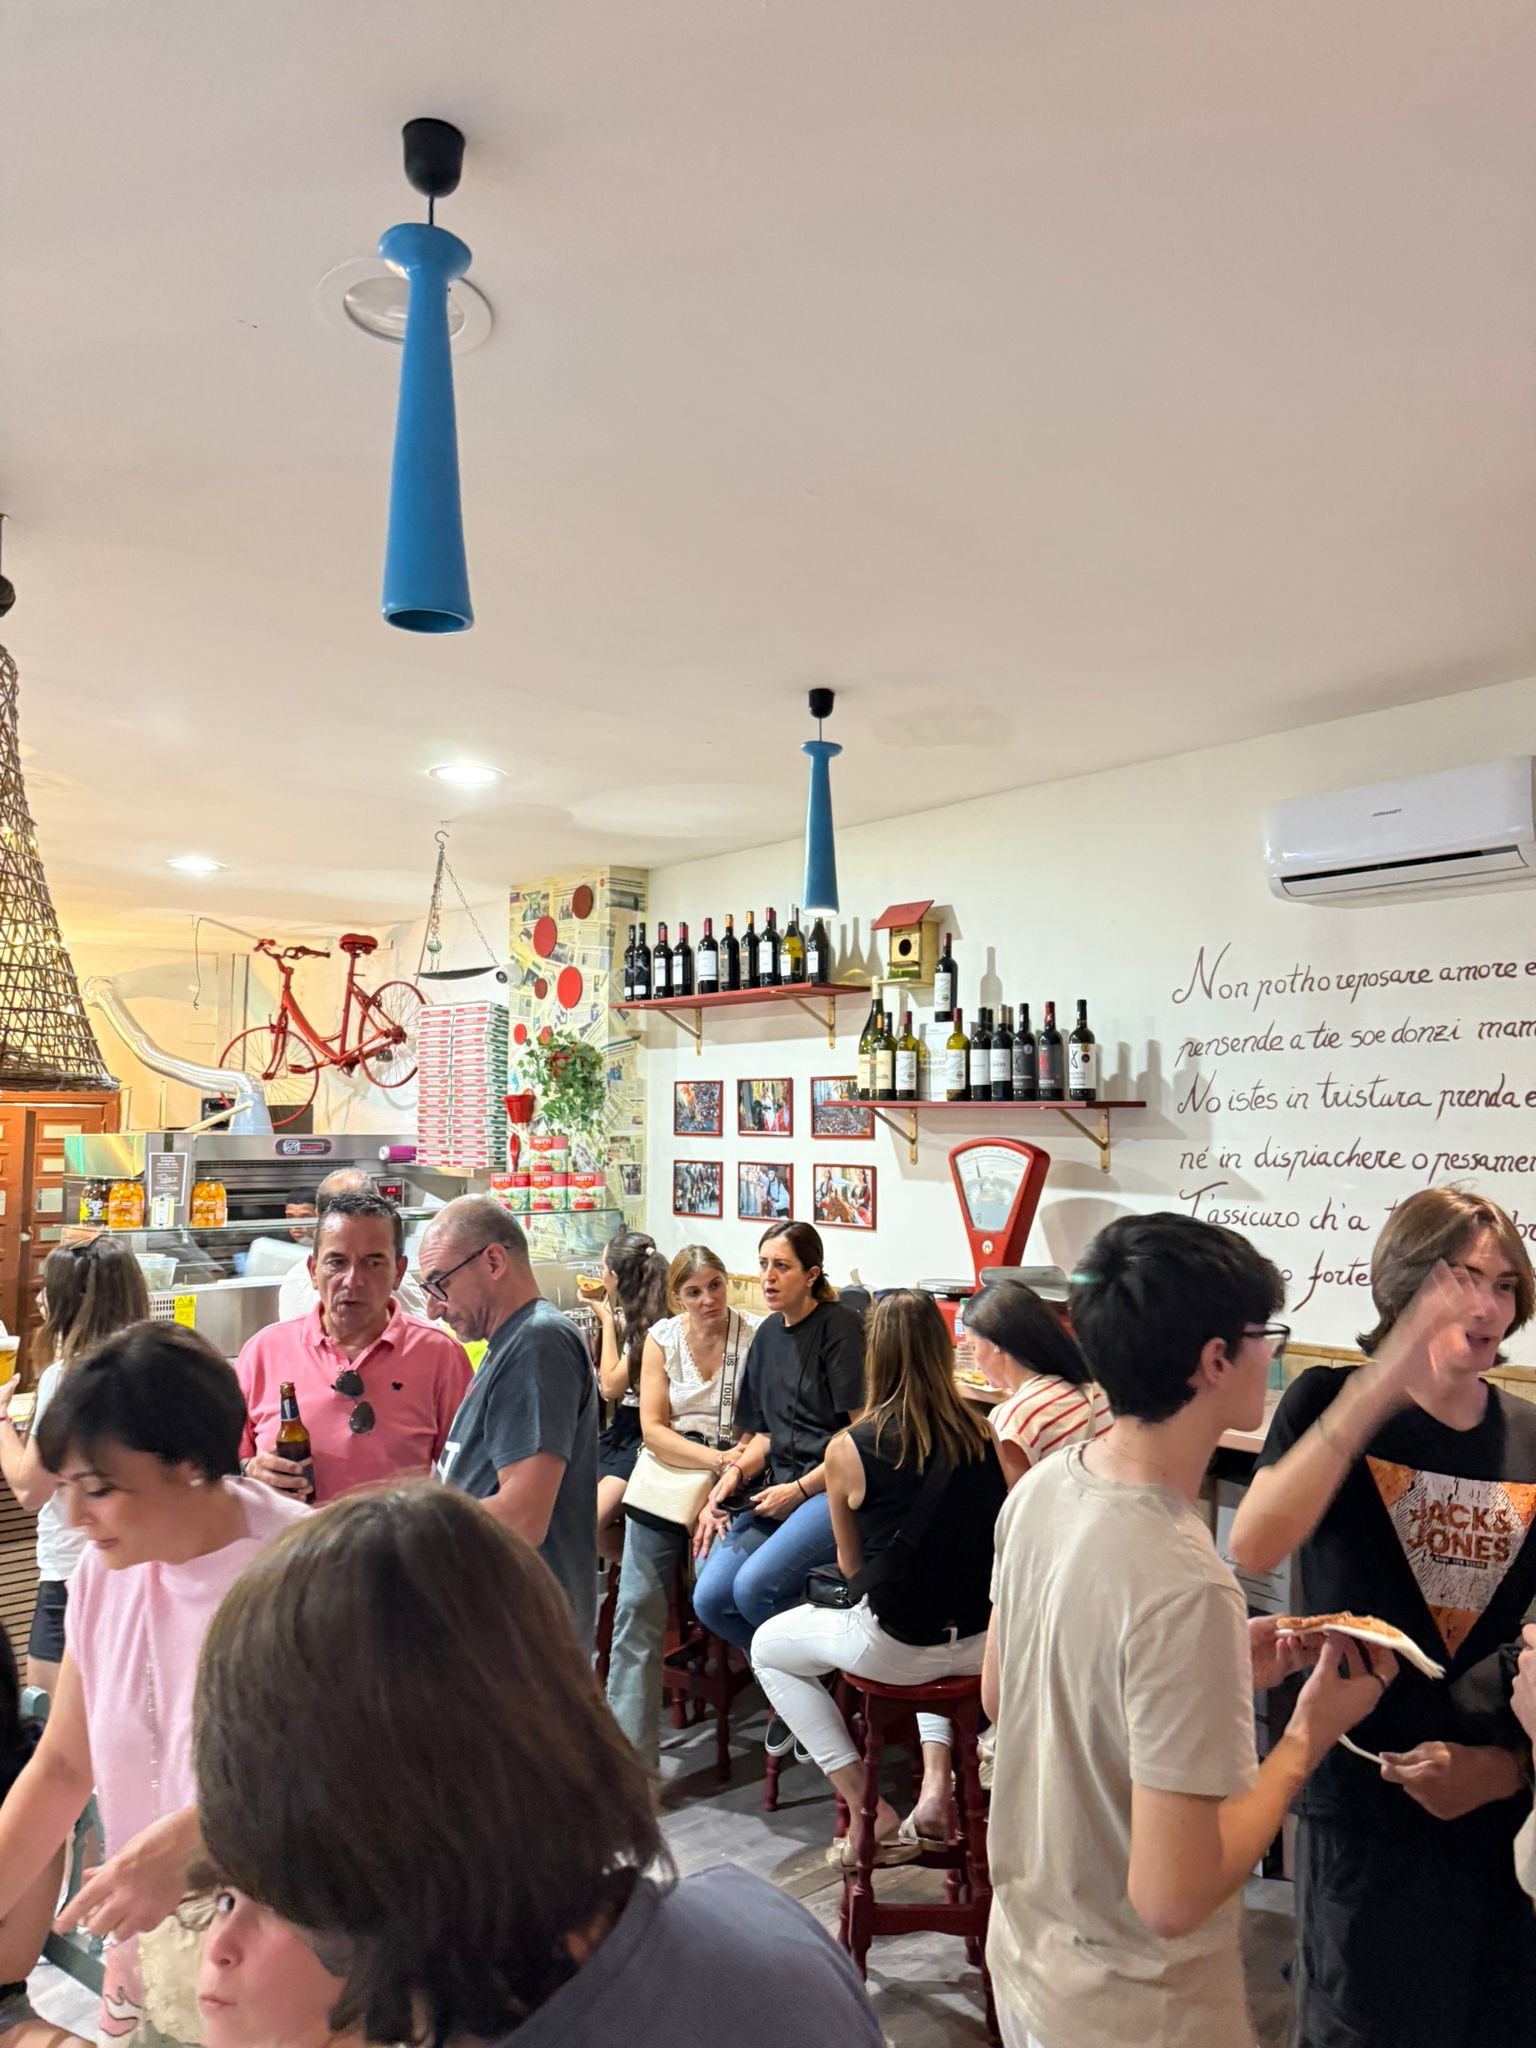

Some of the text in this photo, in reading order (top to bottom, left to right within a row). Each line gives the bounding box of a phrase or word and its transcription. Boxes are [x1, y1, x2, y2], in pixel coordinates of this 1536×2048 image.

[1171, 942, 1249, 1004] Non
[1336, 968, 1434, 1004] reposare
[1439, 962, 1518, 982] amore
[1175, 1019, 1285, 1067] pensende
[1290, 1034, 1306, 1050] a
[1305, 1020, 1344, 1049] tie
[1391, 1016, 1462, 1044] donzi
[1177, 1069, 1221, 1113] No
[1228, 1079, 1278, 1111] istes
[1286, 1086, 1308, 1110] in
[1316, 1072, 1432, 1108] tristura
[1436, 1073, 1520, 1121] prenda
[1180, 1146, 1209, 1170] né
[1219, 1146, 1241, 1168] in
[1254, 1136, 1406, 1182] dispiachere
[1412, 1153, 1428, 1170] o
[1292, 1249, 1371, 1312] forte
[723, 1383, 732, 1406] TOUS
[1406, 1527, 1511, 1563] JONES
